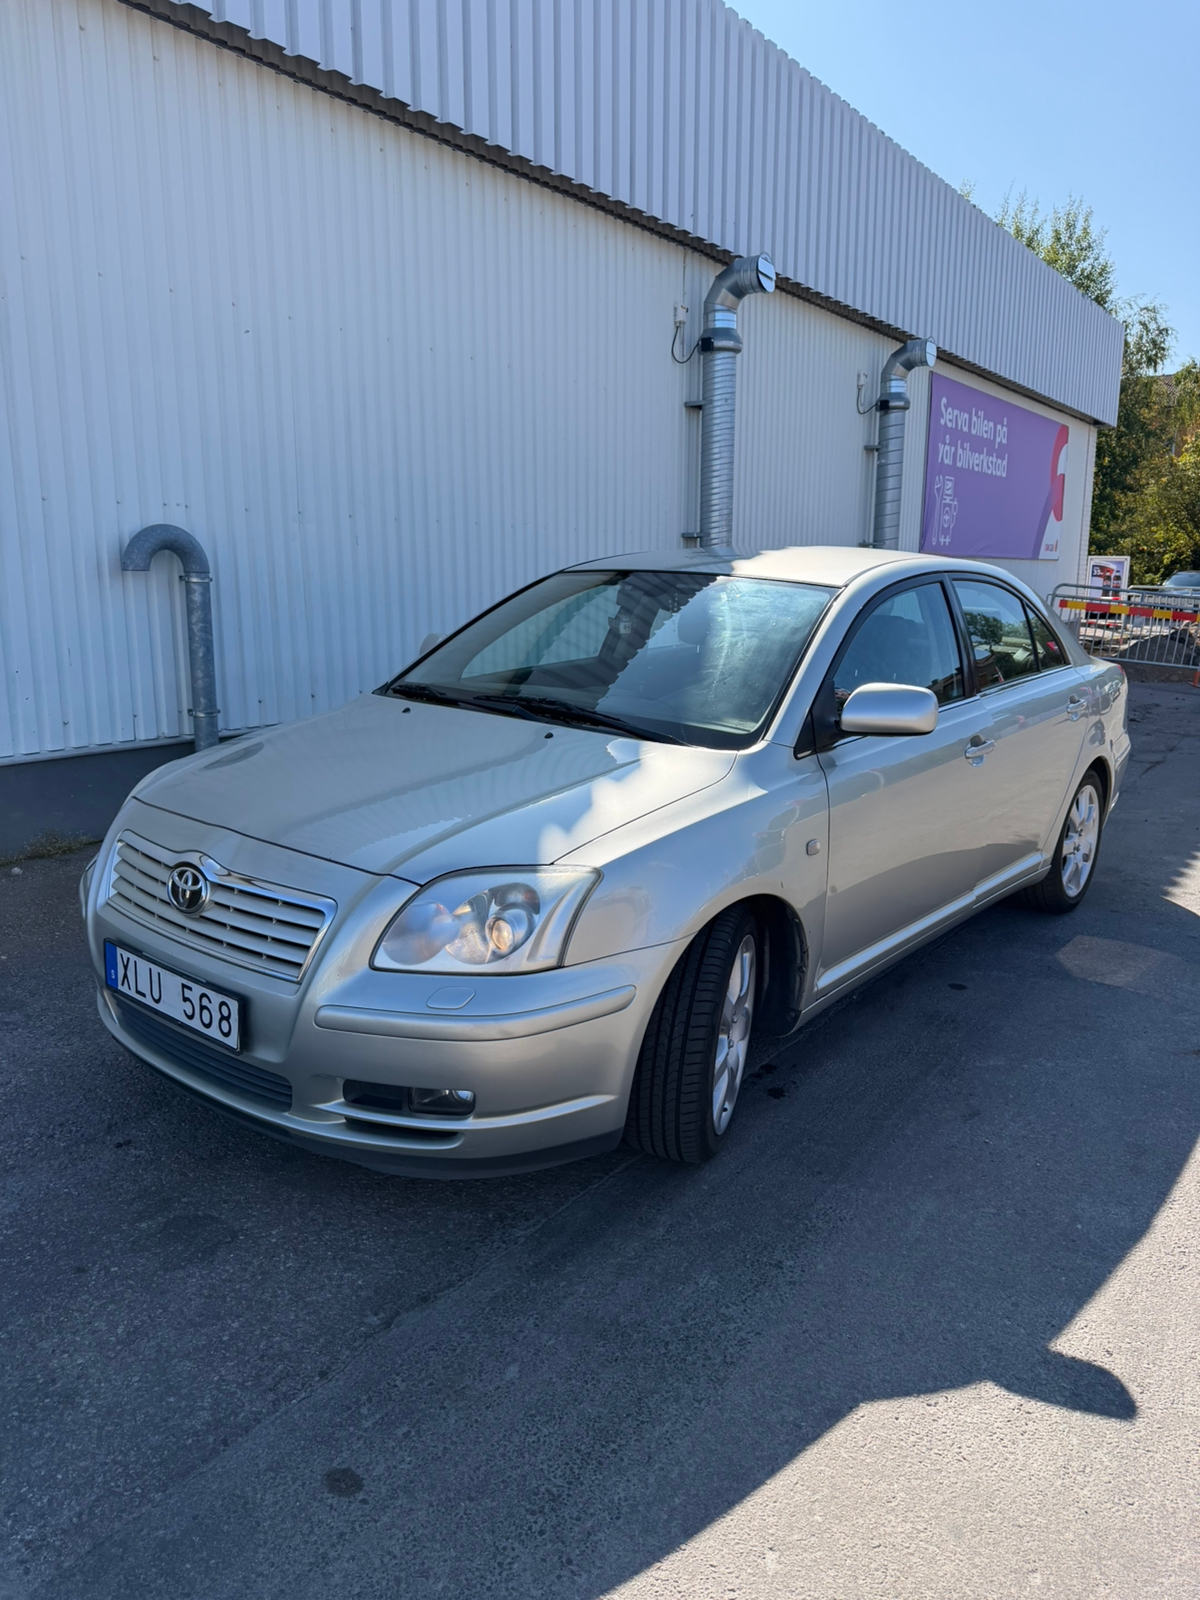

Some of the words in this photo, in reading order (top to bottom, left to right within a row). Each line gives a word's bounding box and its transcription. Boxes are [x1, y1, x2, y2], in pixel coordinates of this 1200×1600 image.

[940, 397, 969, 432] Serva
[971, 408, 994, 440] bilen
[996, 417, 1008, 448] på
[938, 435, 955, 465] vår
[957, 440, 1008, 477] bilverkstad
[120, 953, 162, 1004] XLU
[181, 983, 232, 1038] 568
